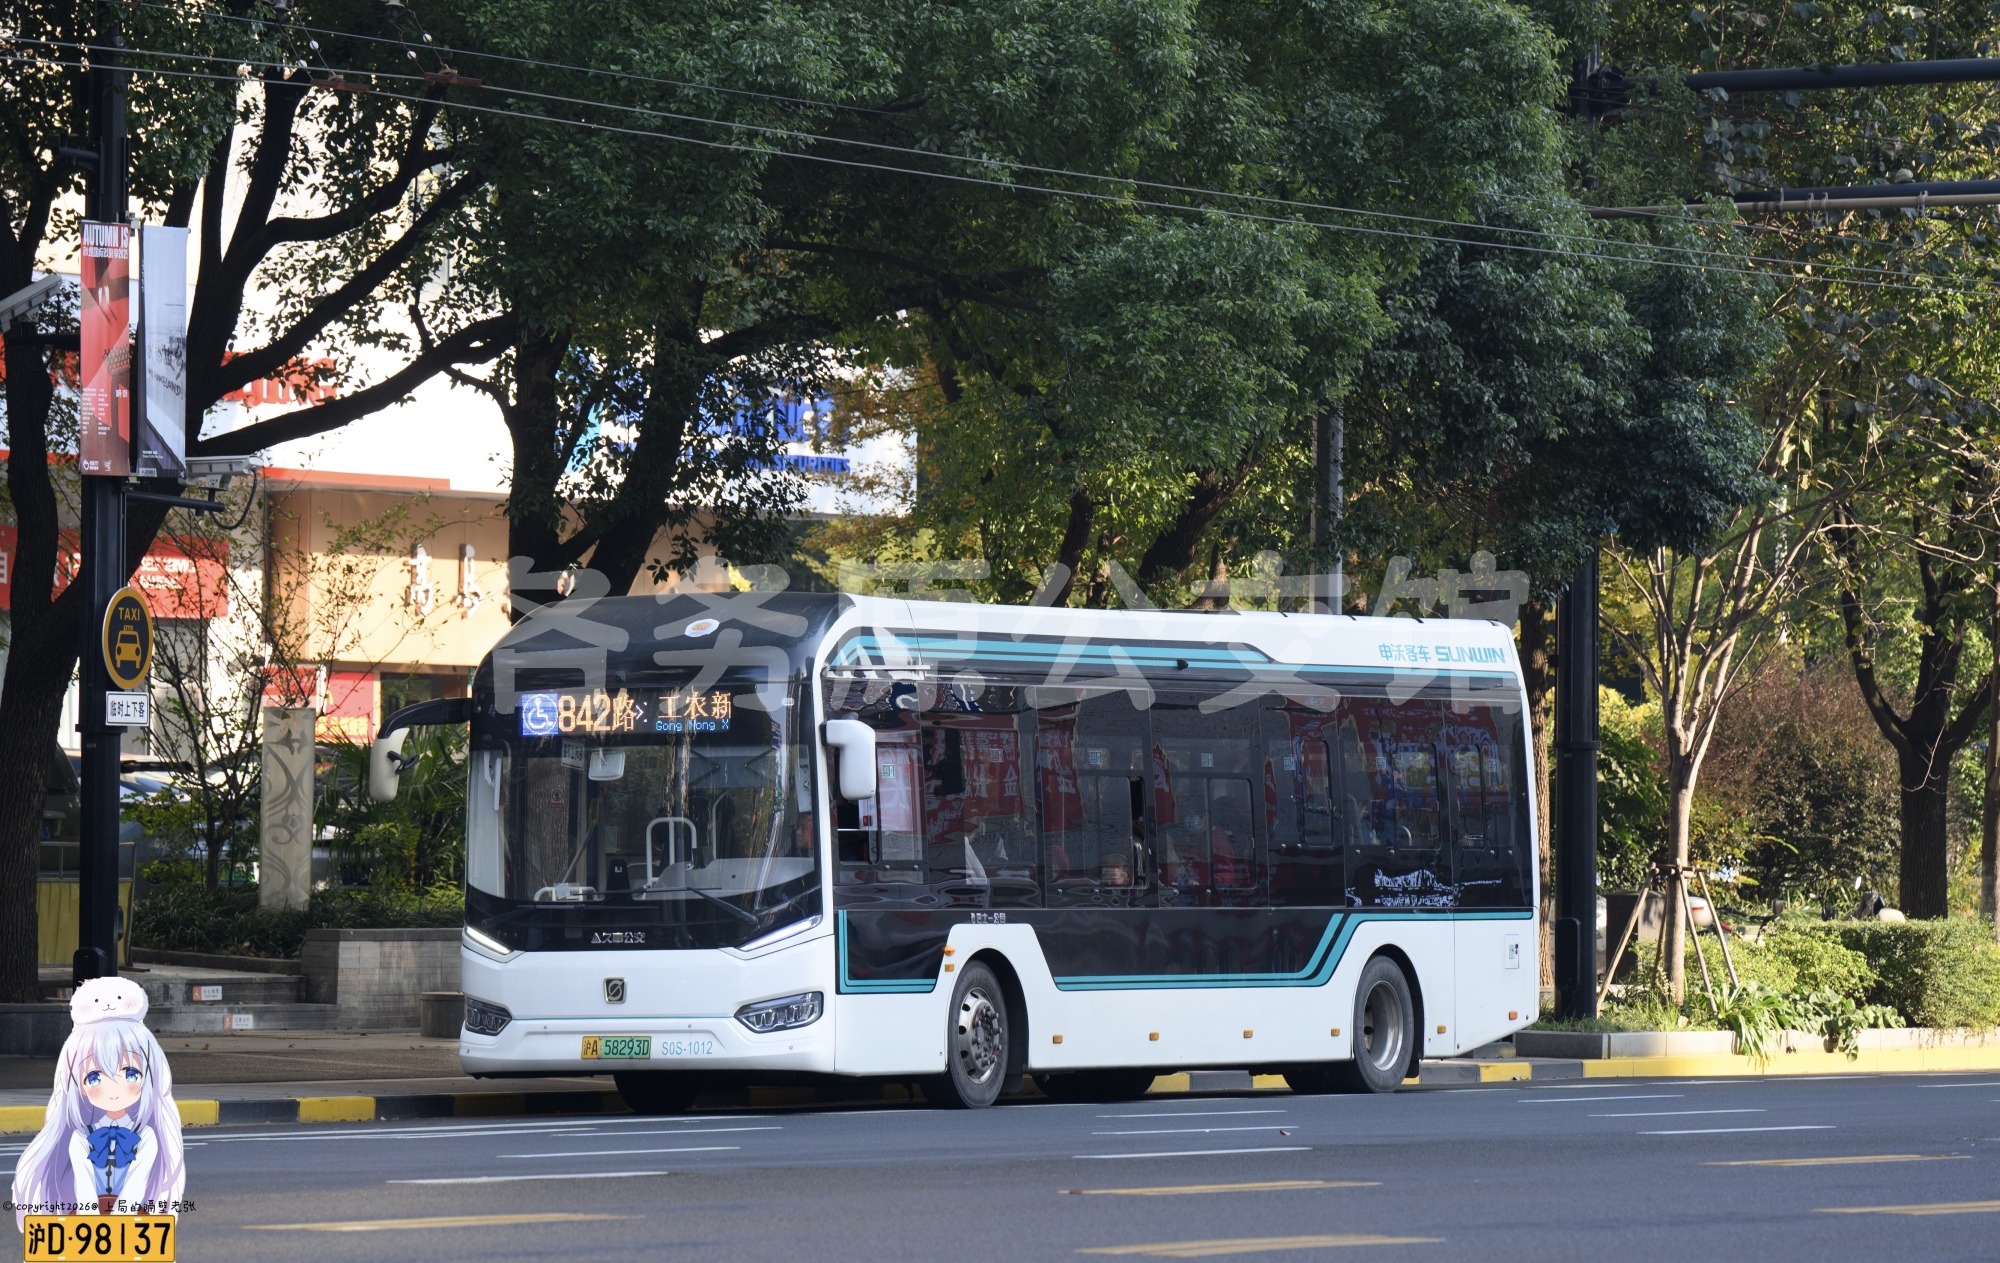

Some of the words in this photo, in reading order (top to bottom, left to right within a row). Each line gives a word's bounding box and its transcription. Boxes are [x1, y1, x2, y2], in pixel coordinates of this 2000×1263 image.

[83, 224, 118, 247] AUTUMN
[120, 226, 129, 248] IS
[118, 607, 140, 621] TAXI
[1378, 643, 1431, 662] 申沃客车
[1435, 646, 1506, 664] SUNWIN
[110, 700, 145, 718] 临时上下客
[558, 693, 637, 732] 842路
[658, 691, 732, 719] 工农新
[655, 720, 682, 731] Gong
[721, 719, 730, 730] X
